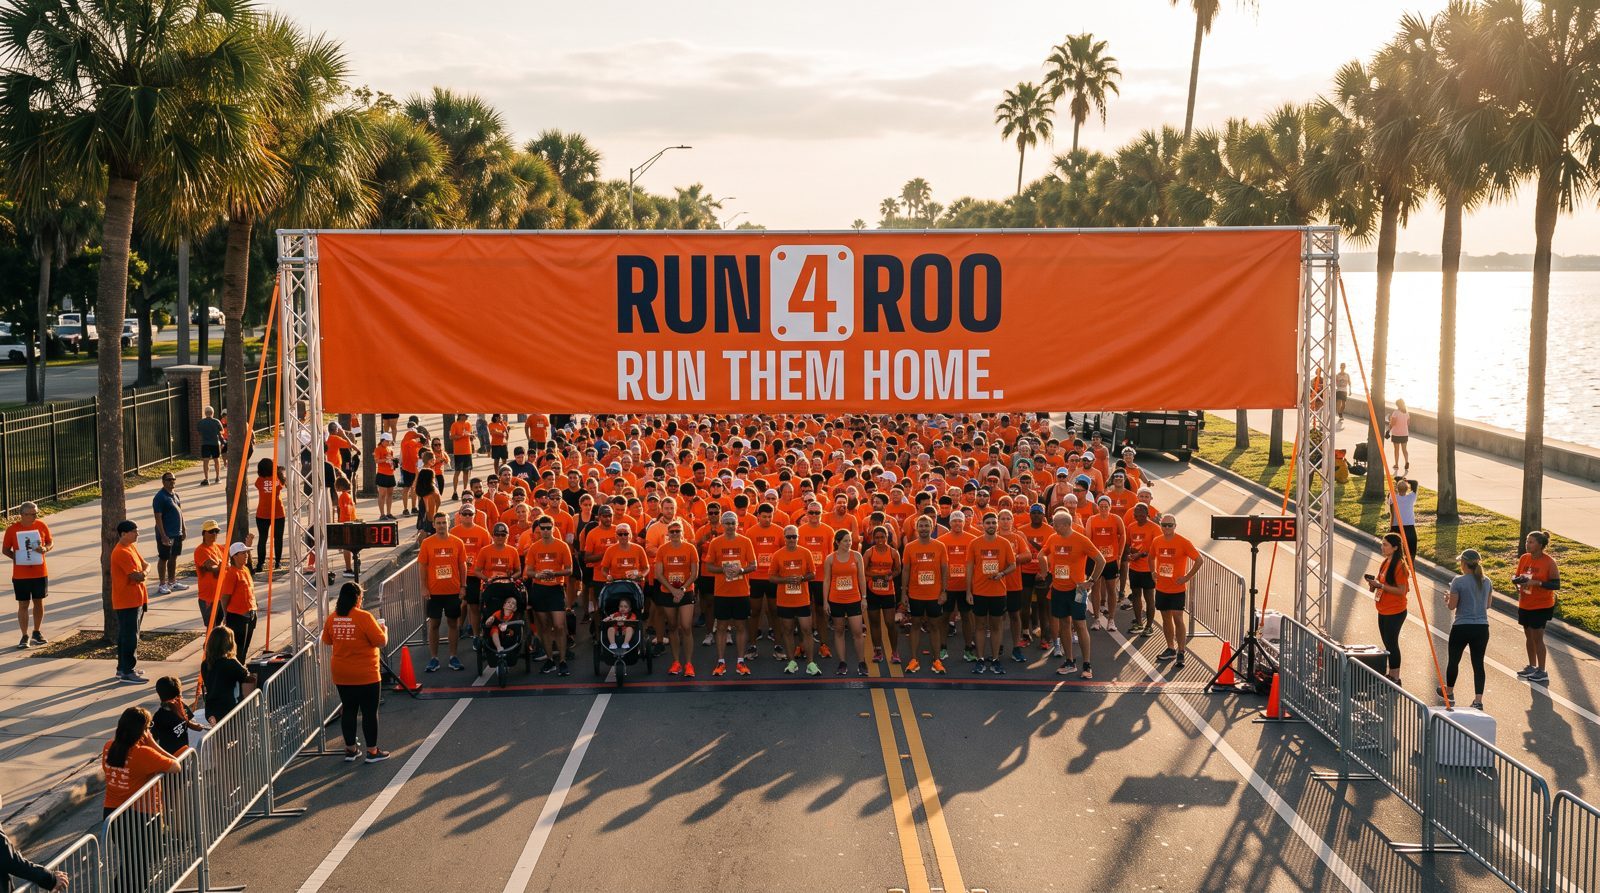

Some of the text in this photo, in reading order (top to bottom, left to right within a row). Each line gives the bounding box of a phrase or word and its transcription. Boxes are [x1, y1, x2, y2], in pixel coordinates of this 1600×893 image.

[617, 253, 1002, 334] RUN 4 ROO
[617, 349, 1004, 401] RUN THEM HOME.
[1247, 519, 1296, 537] 11:35
